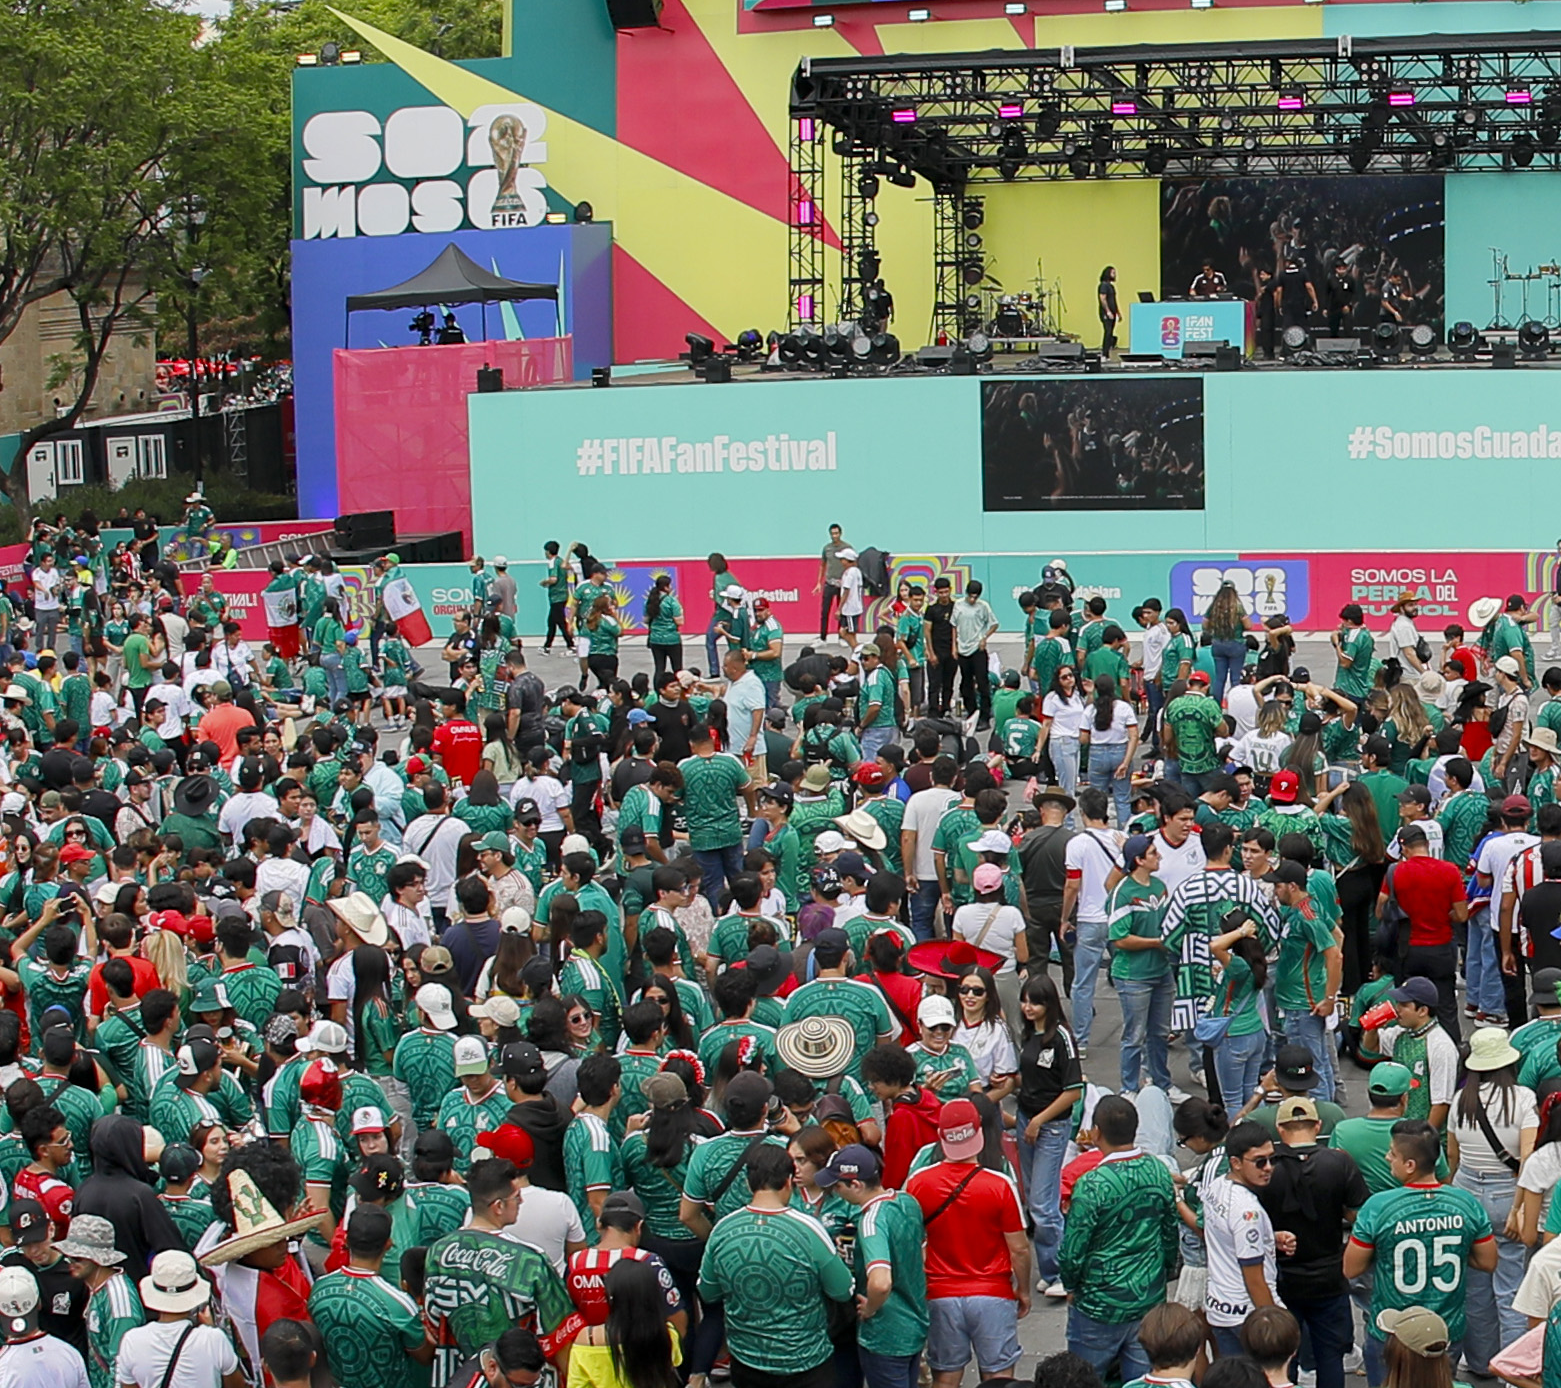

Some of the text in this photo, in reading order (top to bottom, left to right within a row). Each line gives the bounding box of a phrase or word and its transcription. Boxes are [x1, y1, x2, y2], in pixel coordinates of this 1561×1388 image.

[492, 212, 528, 227] FIFA
[576, 431, 837, 476] #FIFAFanFestival
[1351, 568, 1458, 583] SOMOS LA
[1352, 584, 1459, 602] PERLA DEL
[1394, 1214, 1464, 1235] ANTONIO
[1393, 1235, 1463, 1294] 05
[1206, 1296, 1249, 1316] KRON
